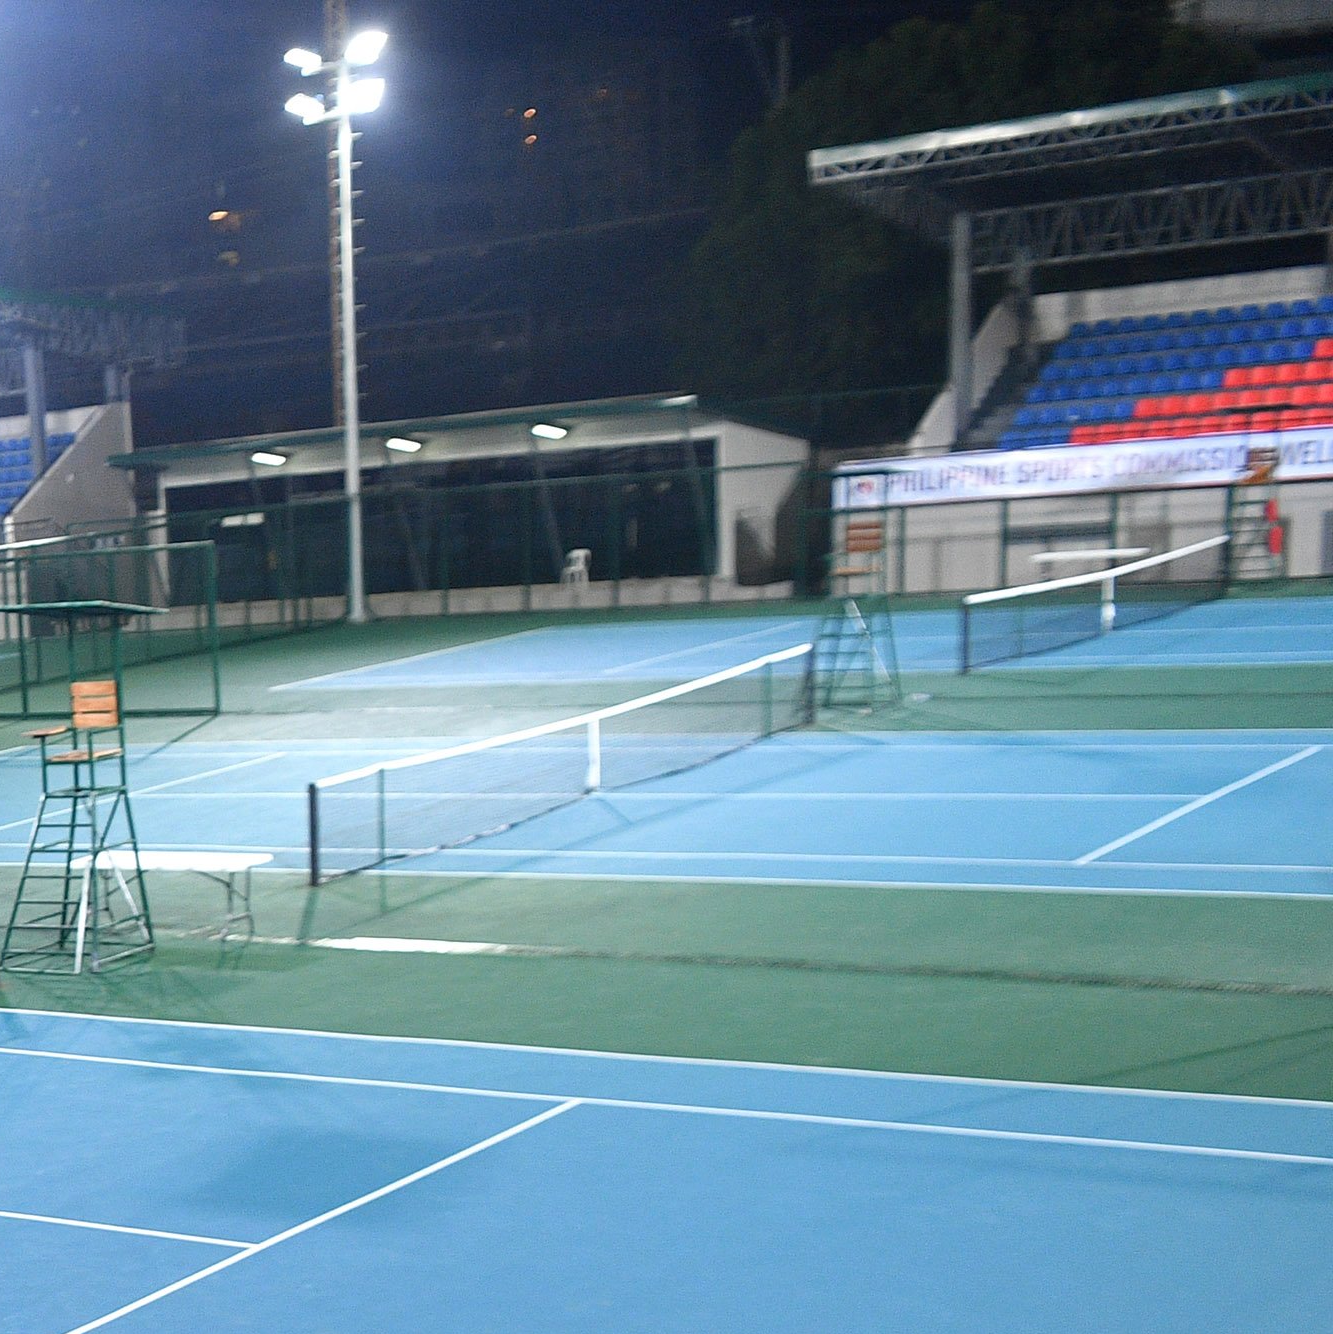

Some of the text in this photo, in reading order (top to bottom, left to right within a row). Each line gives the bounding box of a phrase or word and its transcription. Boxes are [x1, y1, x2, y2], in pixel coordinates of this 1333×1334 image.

[888, 464, 1011, 492] PHILIPPINE
[1017, 455, 1104, 484] SPORTS
[1114, 443, 1259, 476] COMMISSIO
